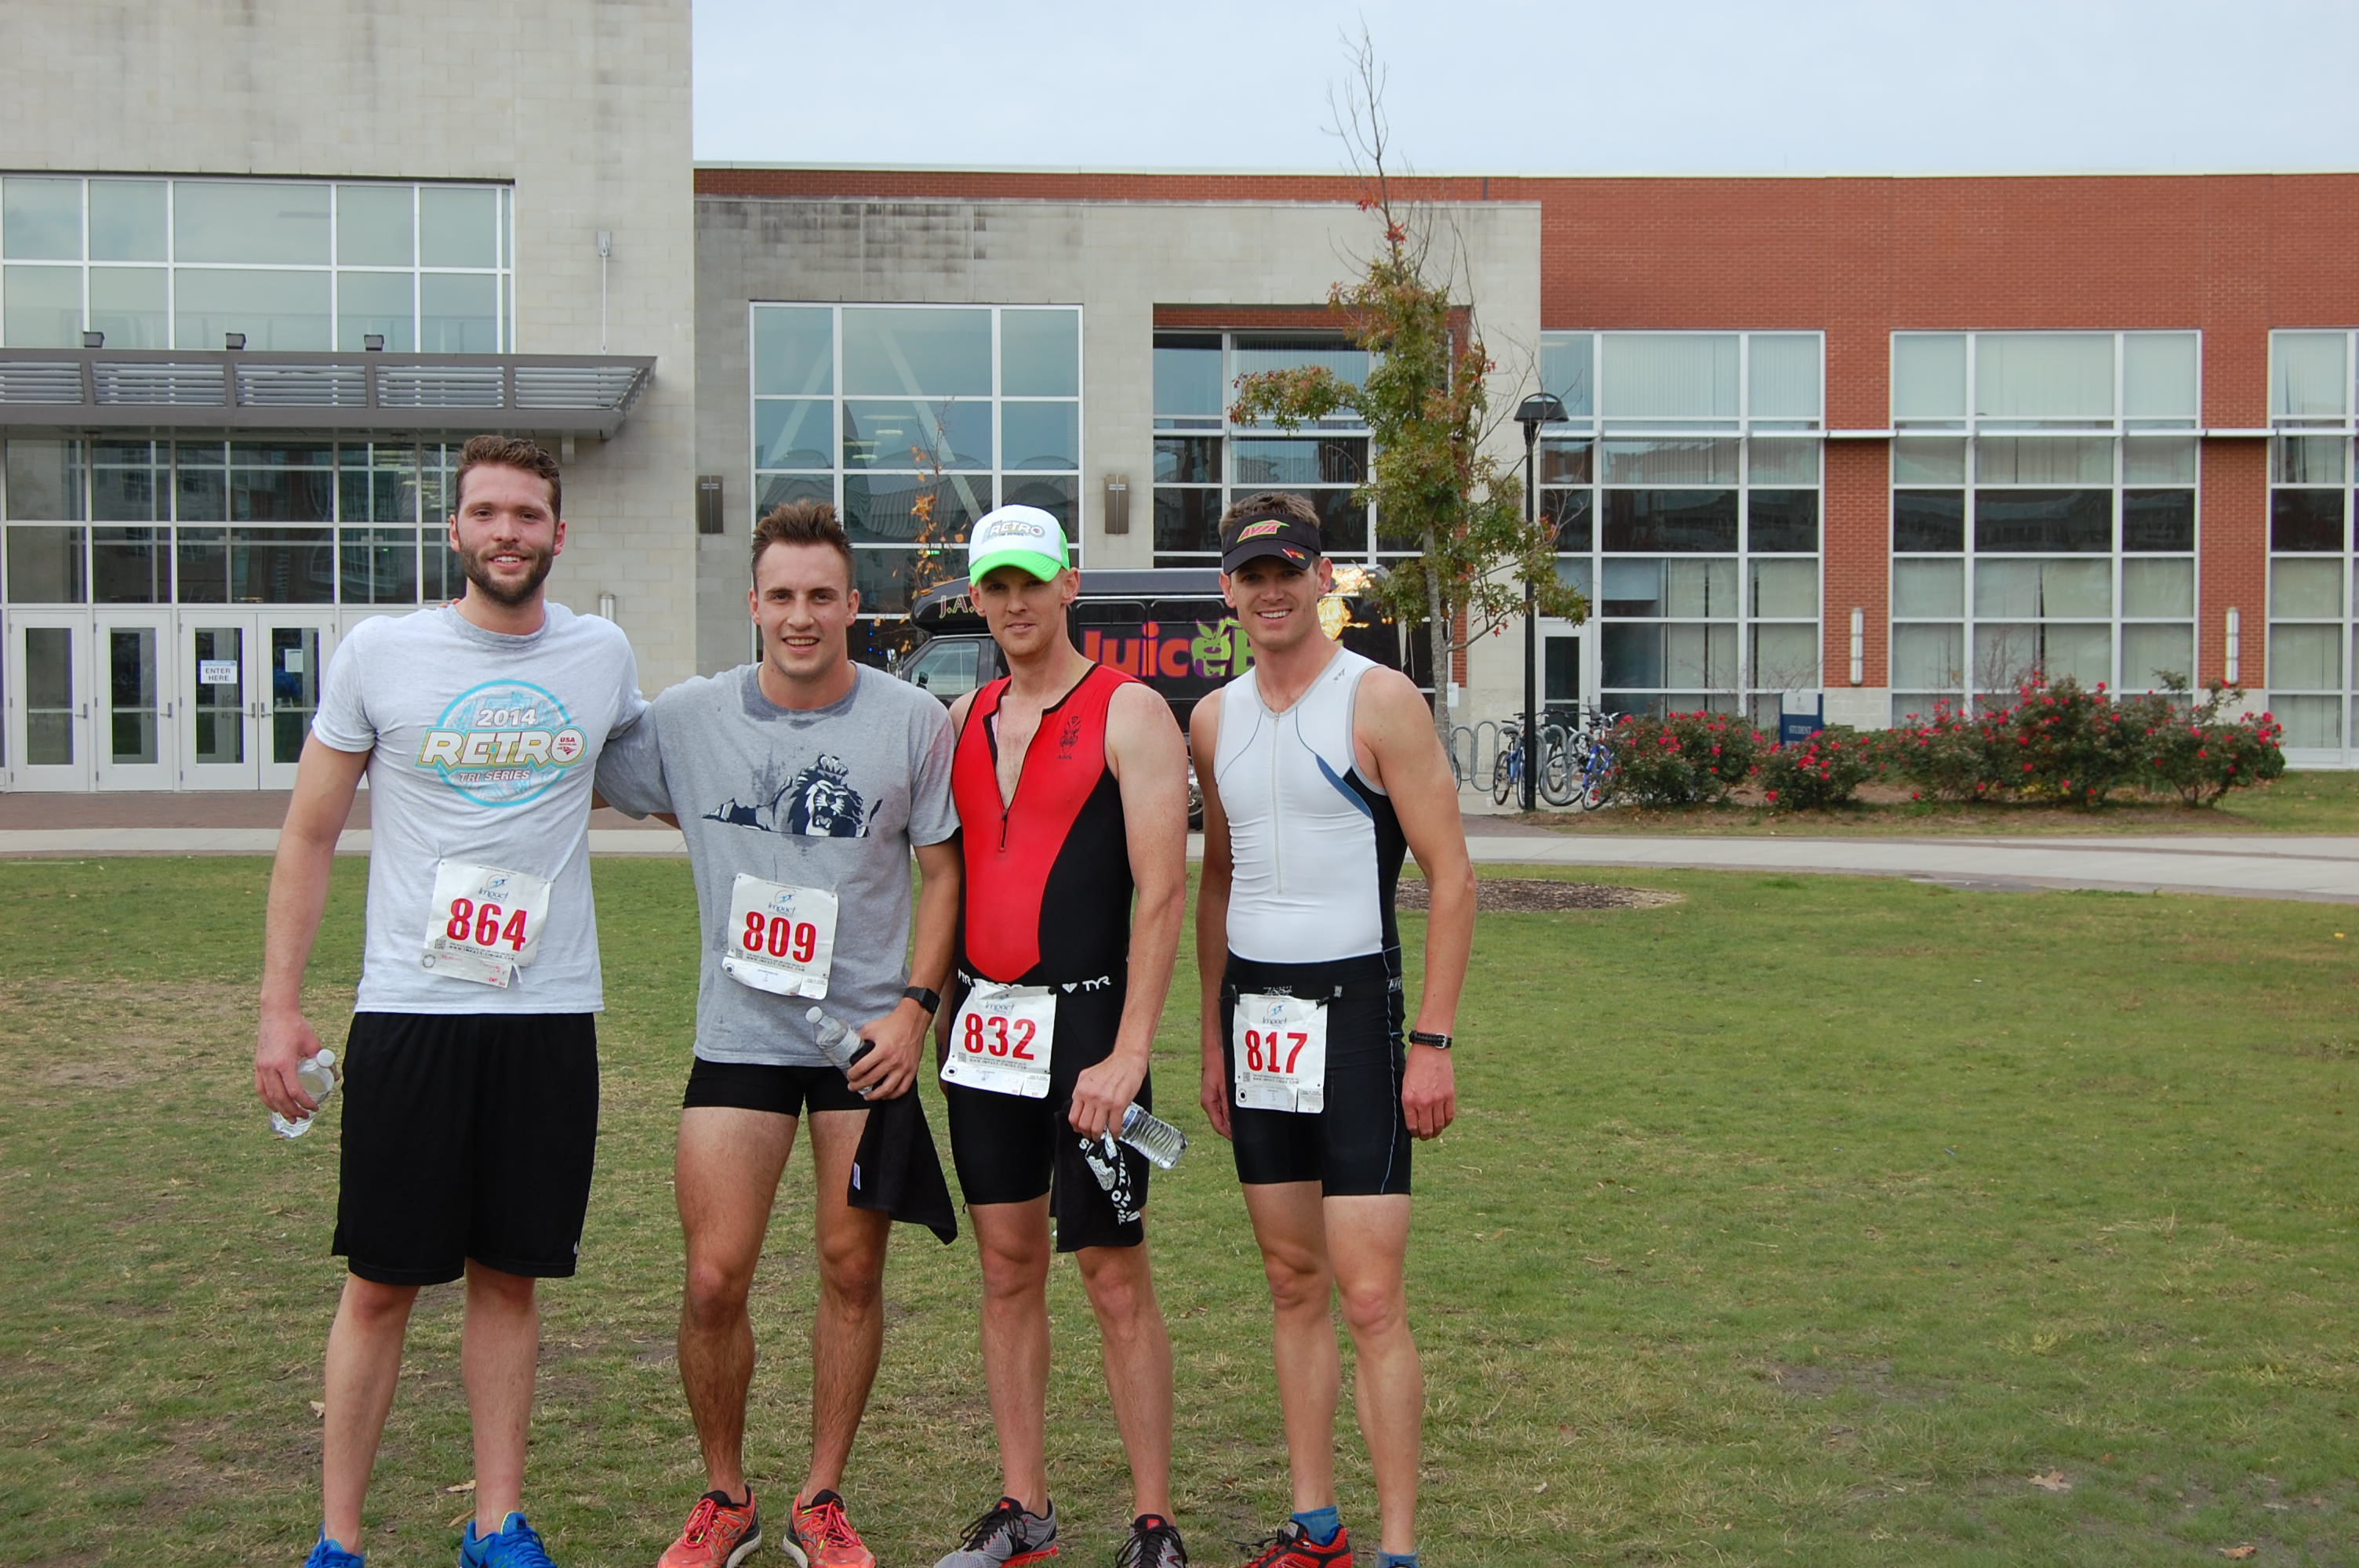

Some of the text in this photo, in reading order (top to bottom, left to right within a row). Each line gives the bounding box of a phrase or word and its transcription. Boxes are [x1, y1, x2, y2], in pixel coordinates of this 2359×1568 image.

[477, 709, 537, 727] 2014
[420, 727, 584, 767] RETRO
[459, 769, 530, 782] TRI SERIES
[446, 898, 528, 952] 864
[743, 911, 816, 964] 809
[1082, 975, 1112, 992] TYR
[964, 1012, 1037, 1061] 832
[1245, 1029, 1308, 1074] 817
